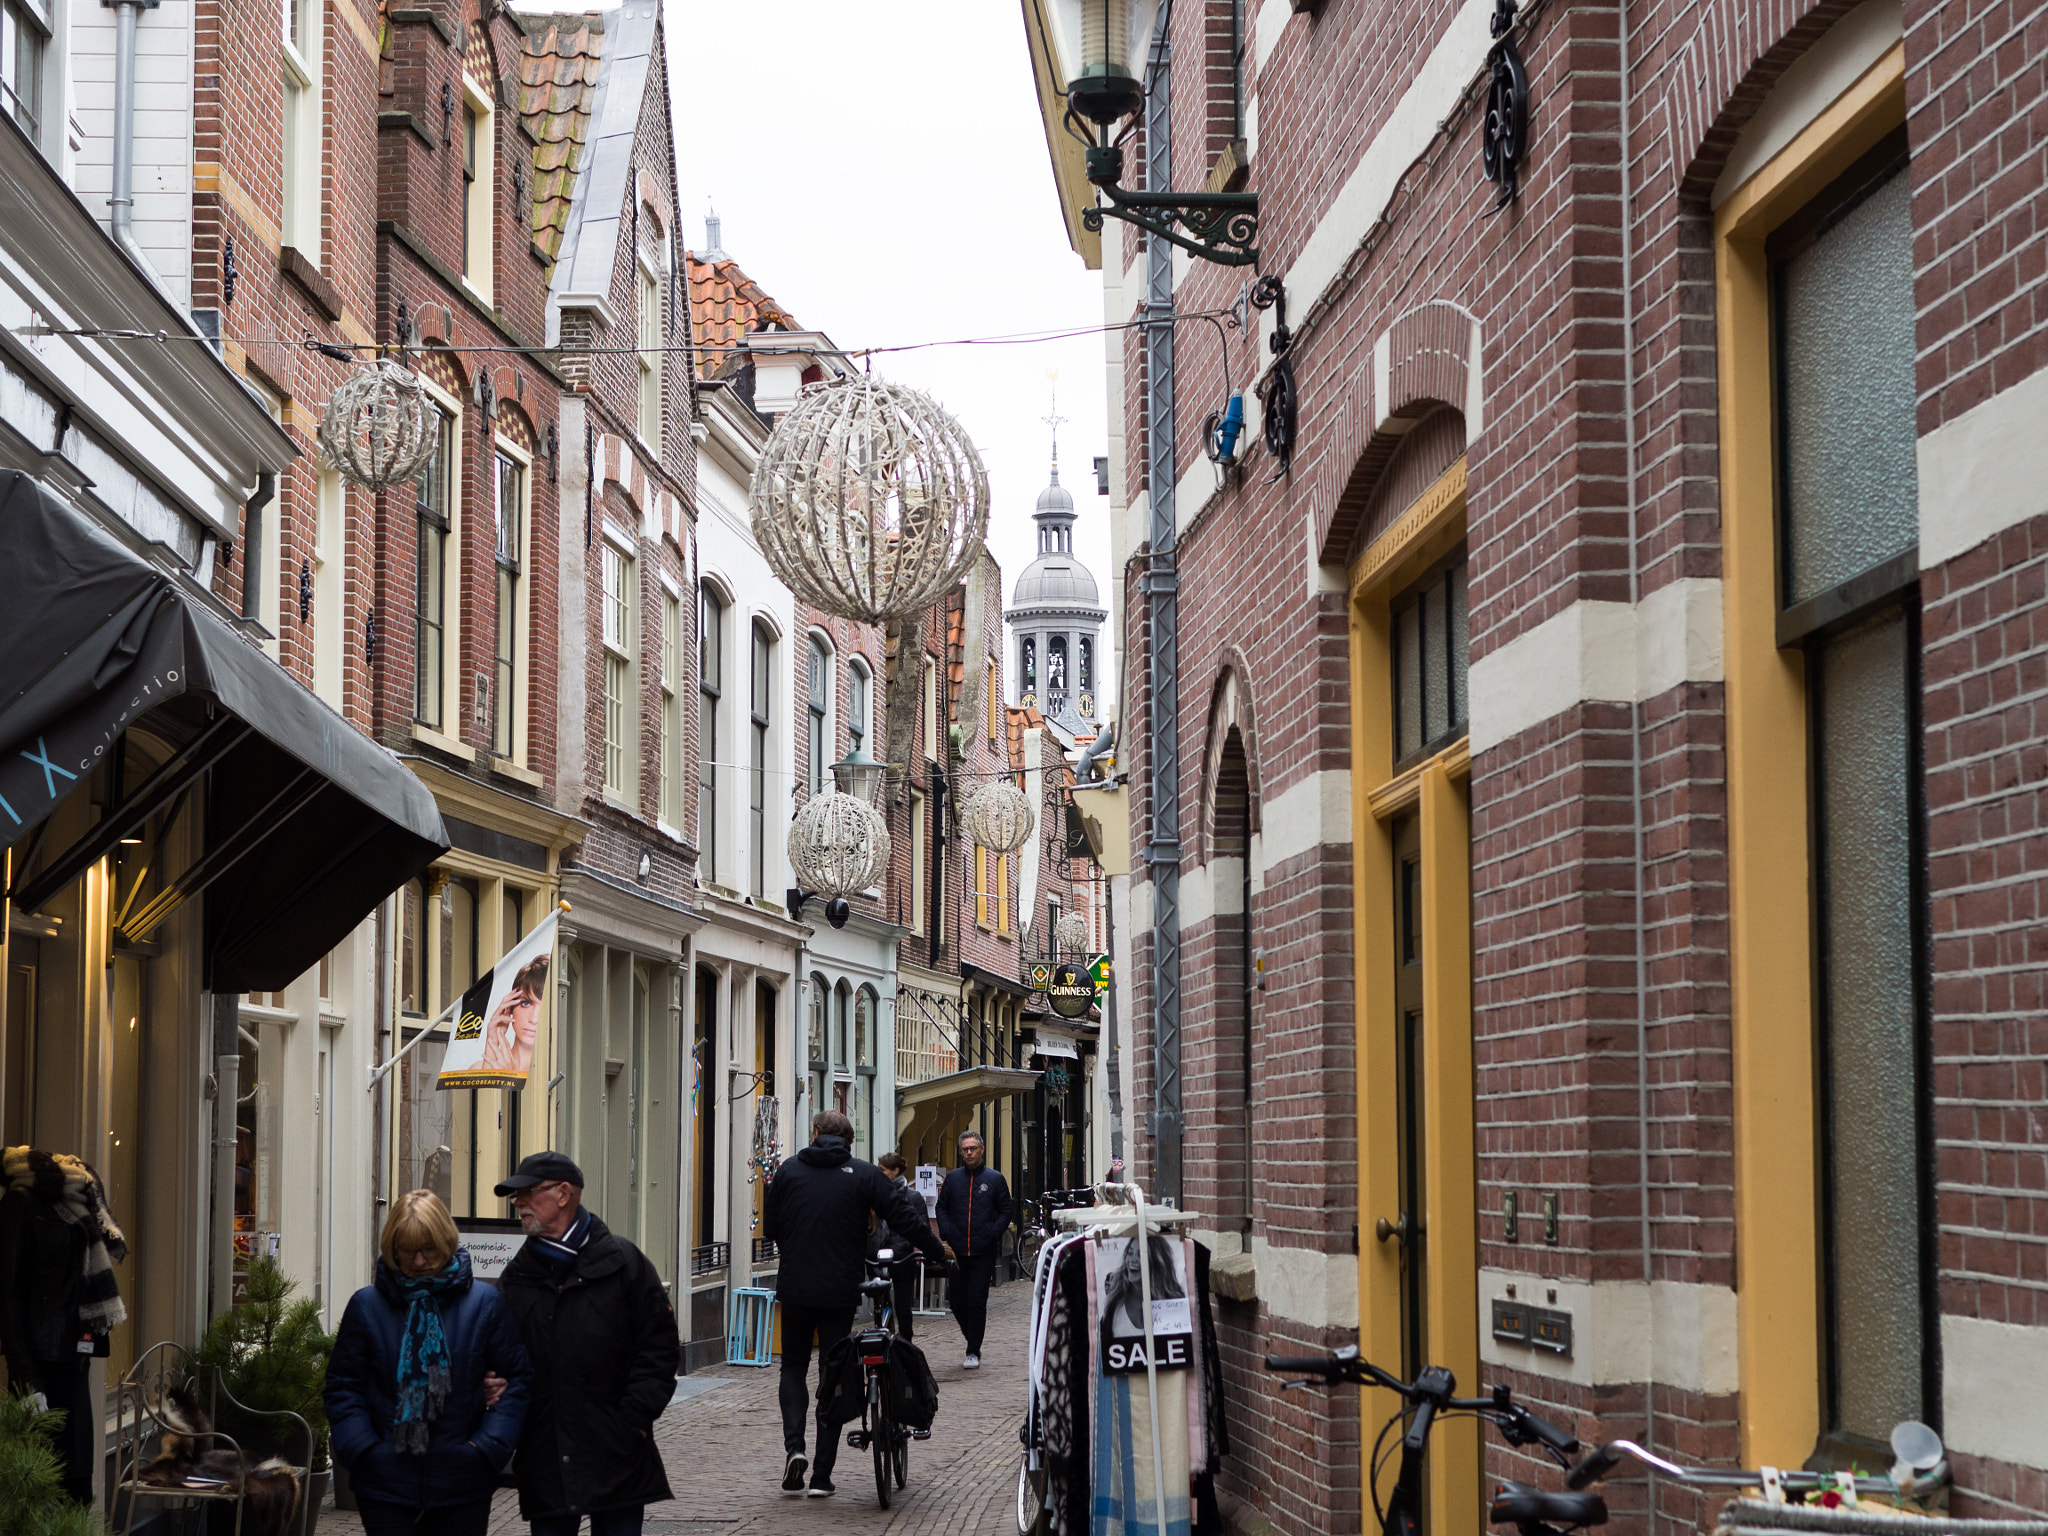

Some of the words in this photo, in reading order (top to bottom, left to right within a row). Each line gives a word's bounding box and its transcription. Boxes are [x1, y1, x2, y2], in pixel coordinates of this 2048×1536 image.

[1050, 984, 1092, 997] GUINNESS
[444, 1079, 516, 1087] WWW.COCOBEAUTY.NL
[459, 1241, 512, 1252] choonheids-
